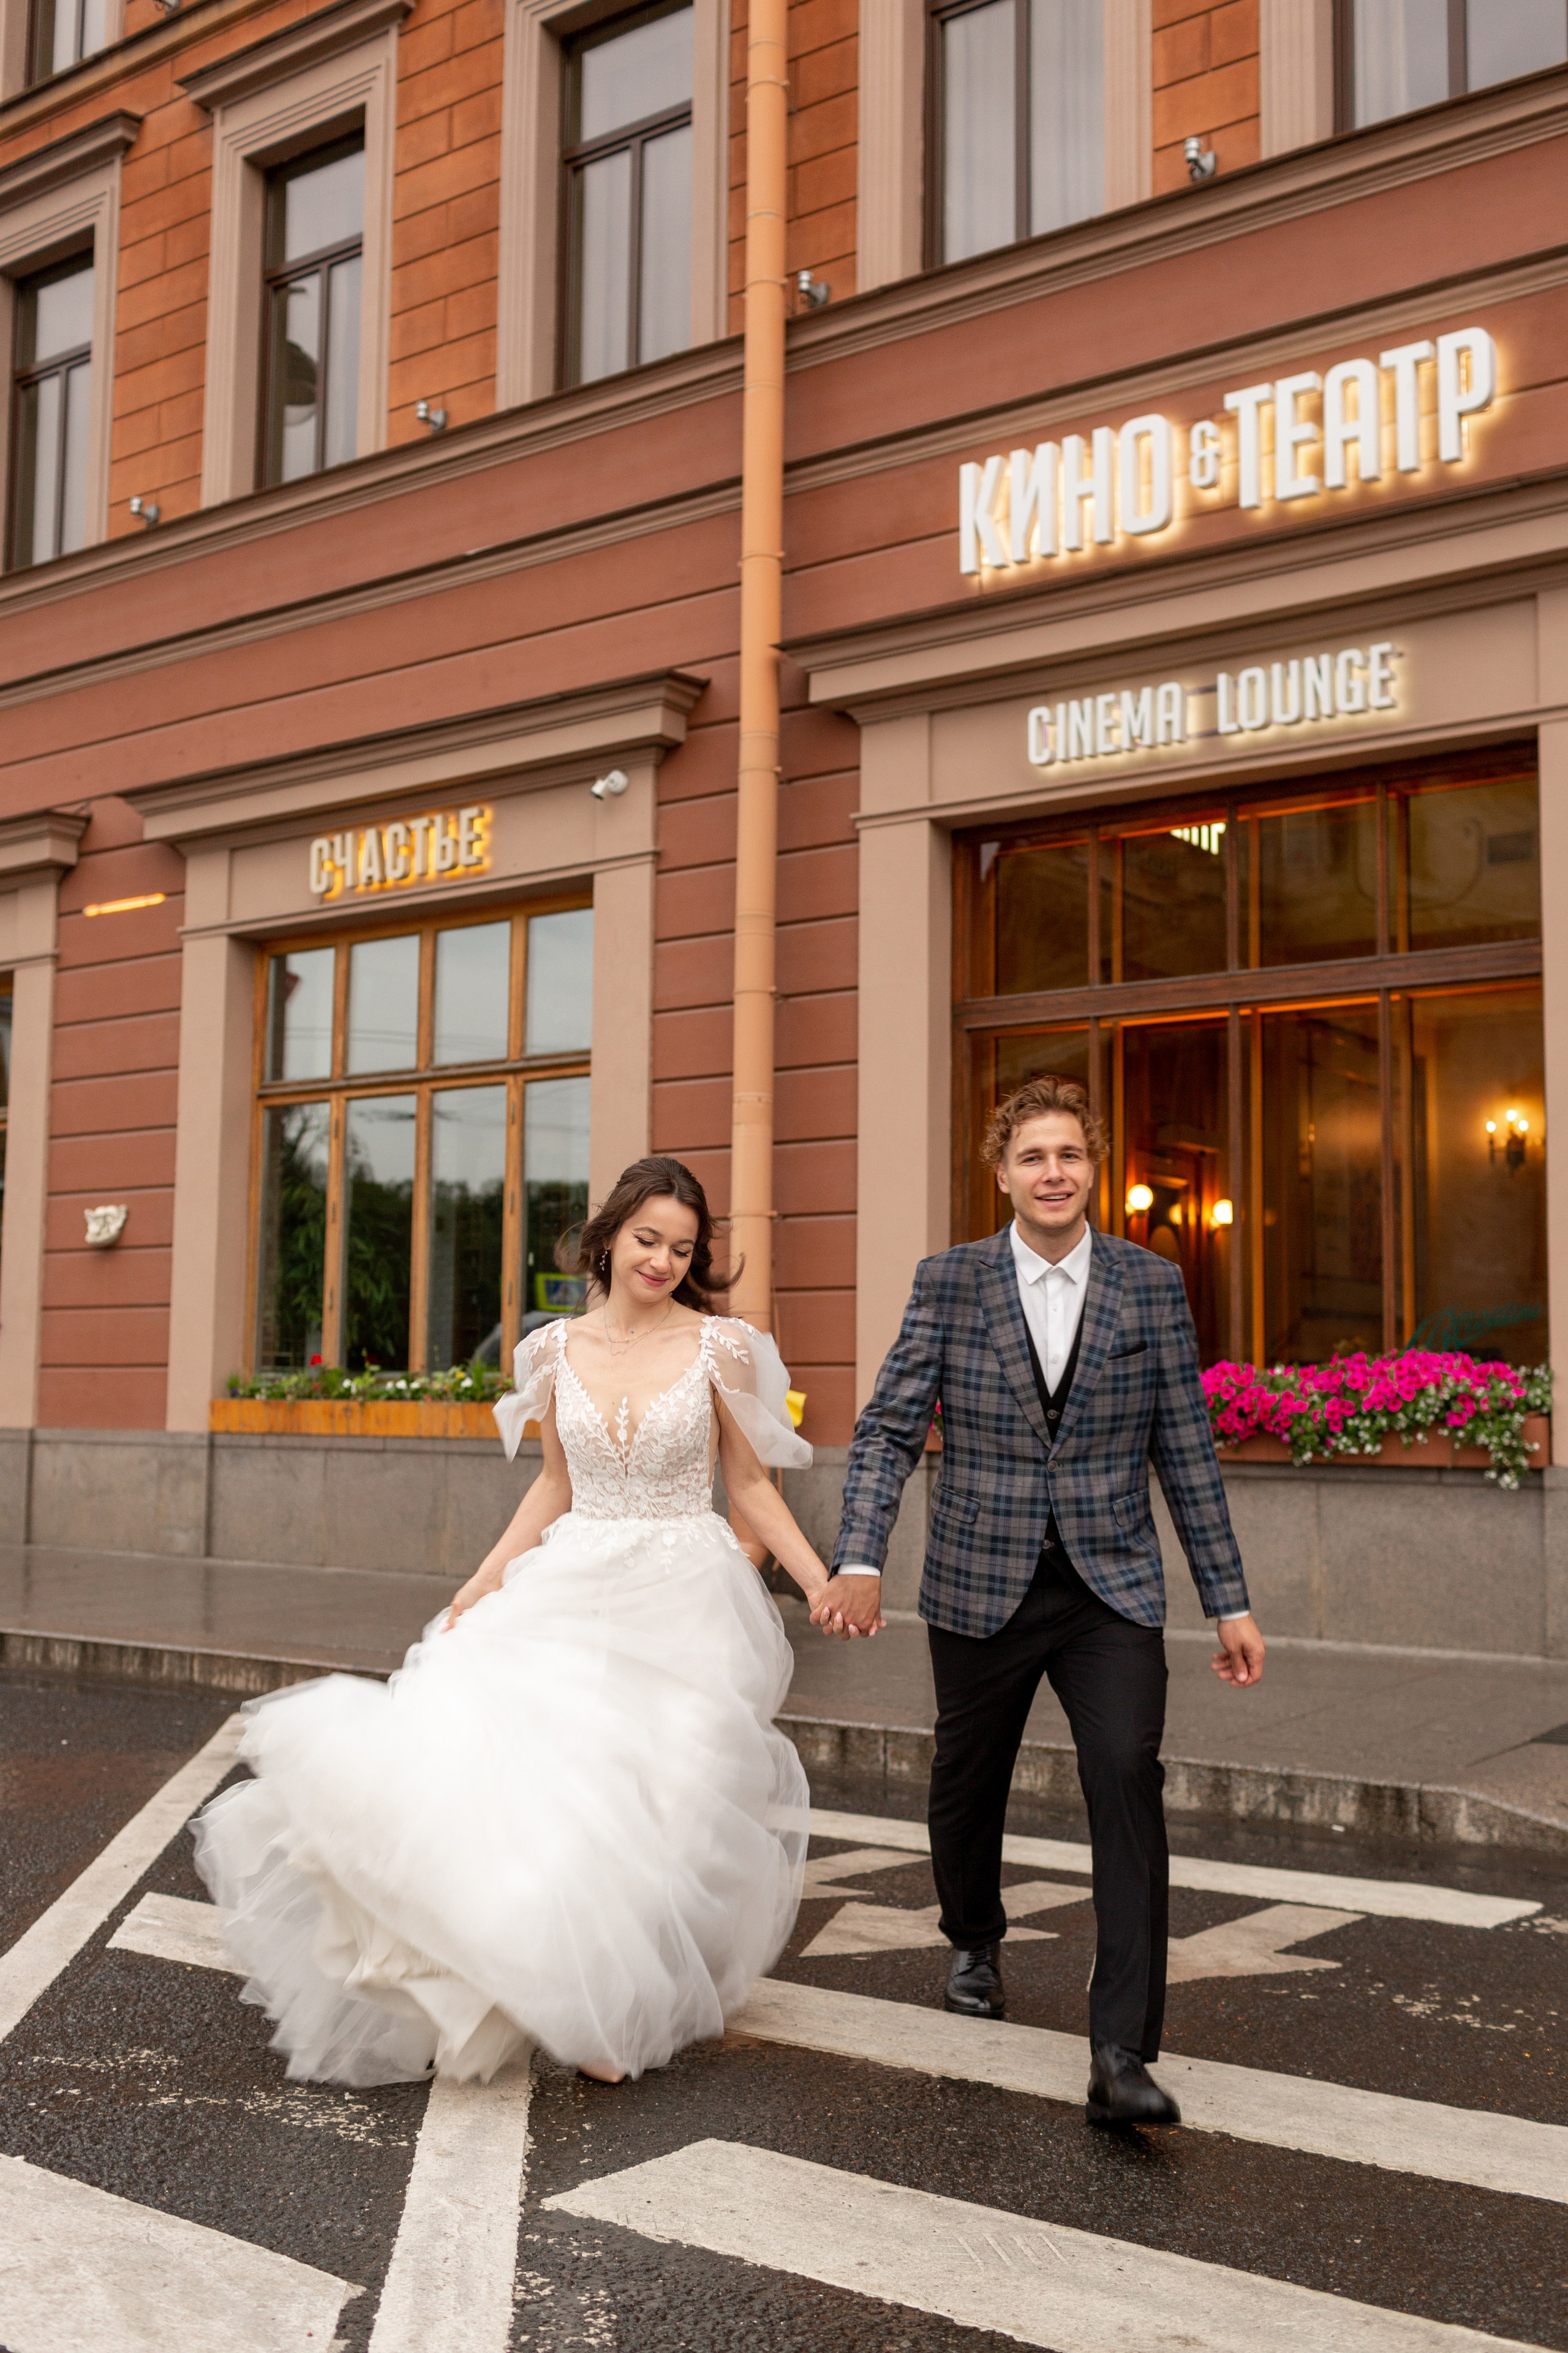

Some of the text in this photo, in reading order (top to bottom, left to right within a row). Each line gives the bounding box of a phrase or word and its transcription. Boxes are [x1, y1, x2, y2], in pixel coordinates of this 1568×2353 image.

[959, 326, 1496, 575] КИНО & ТЕАТР
[1027, 641, 1397, 766] CINEMA LOUNGE
[309, 806, 484, 895] СЧАСТЬЕ
